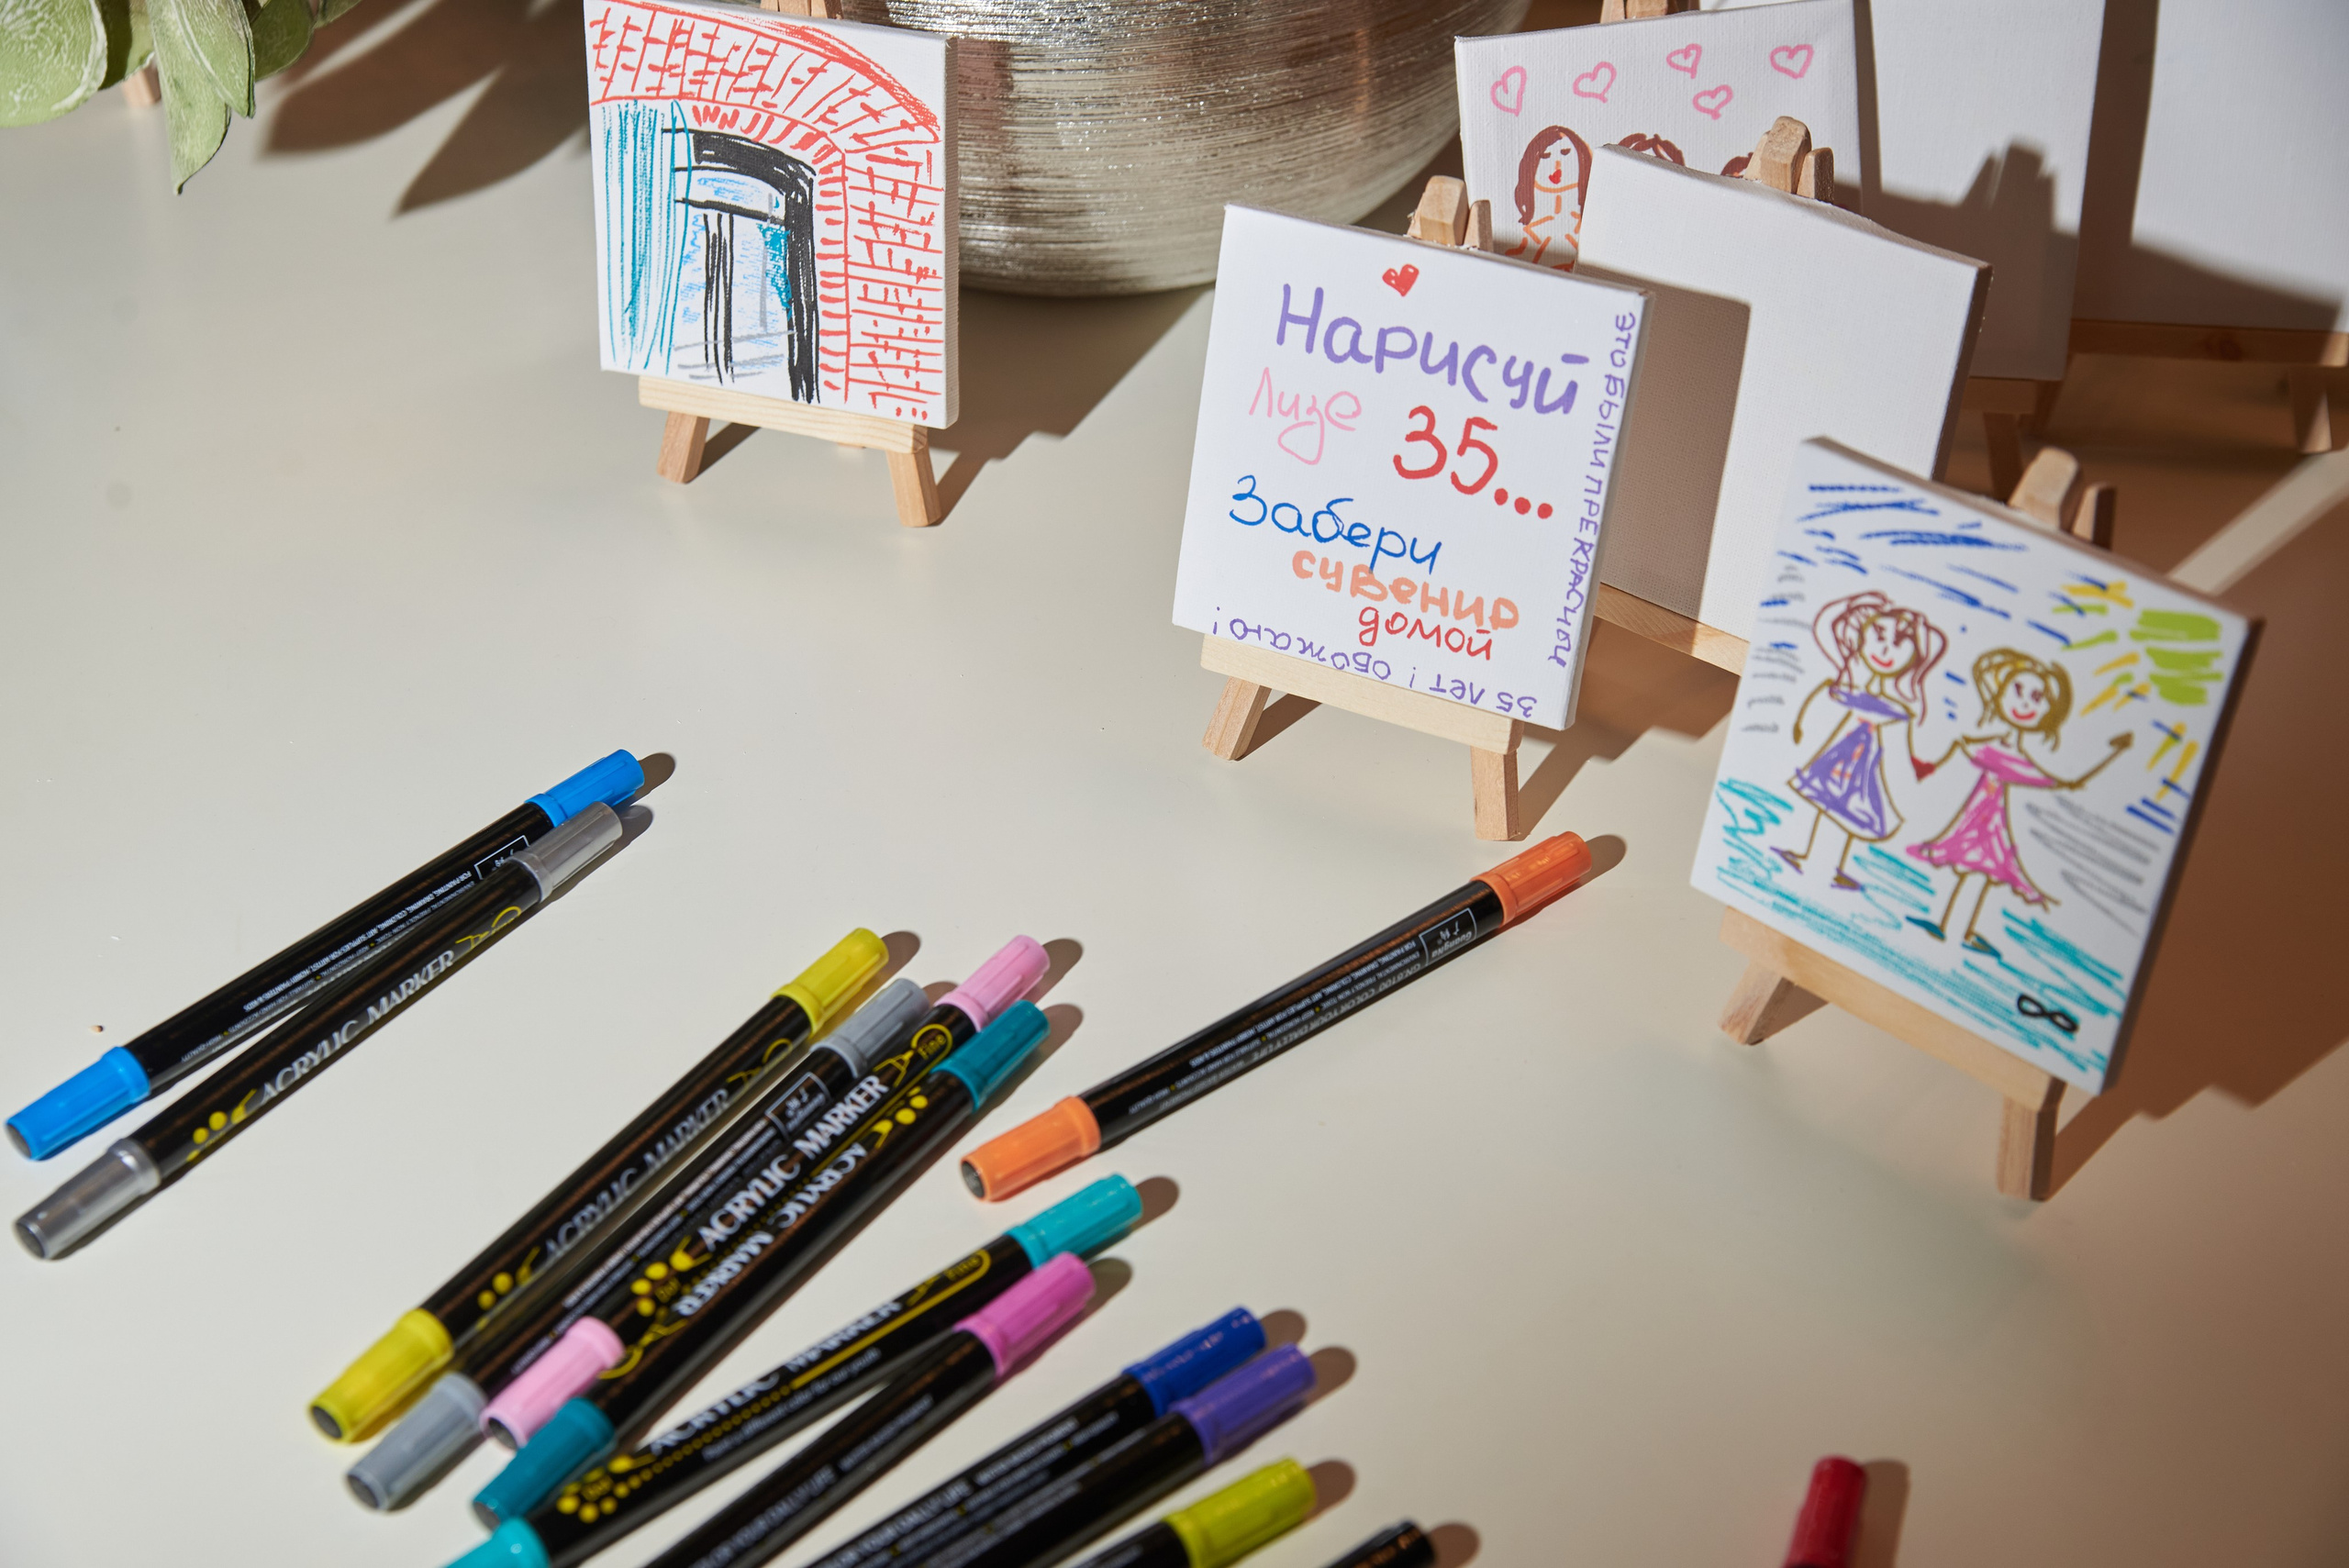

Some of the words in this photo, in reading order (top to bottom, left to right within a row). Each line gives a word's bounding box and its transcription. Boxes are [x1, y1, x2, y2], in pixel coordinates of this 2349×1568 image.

[1277, 283, 1589, 415] Нарисуй
[1608, 312, 1636, 369] ЭТО
[1229, 474, 1443, 574] Забери
[1291, 550, 1520, 630] сувенир
[1358, 606, 1493, 661] домой
[262, 1017, 360, 1106] ACRYLIC
[370, 947, 455, 1024] MARKER
[546, 1164, 640, 1265] ACRYLIC
[646, 1085, 730, 1175] MARKER
[697, 1147, 804, 1254] ACRYLIC
[795, 1068, 890, 1162] MARKER
[915, 1029, 949, 1062] Fine
[764, 1140, 869, 1233] ACRYLIC
[669, 1225, 774, 1320] MARKER
